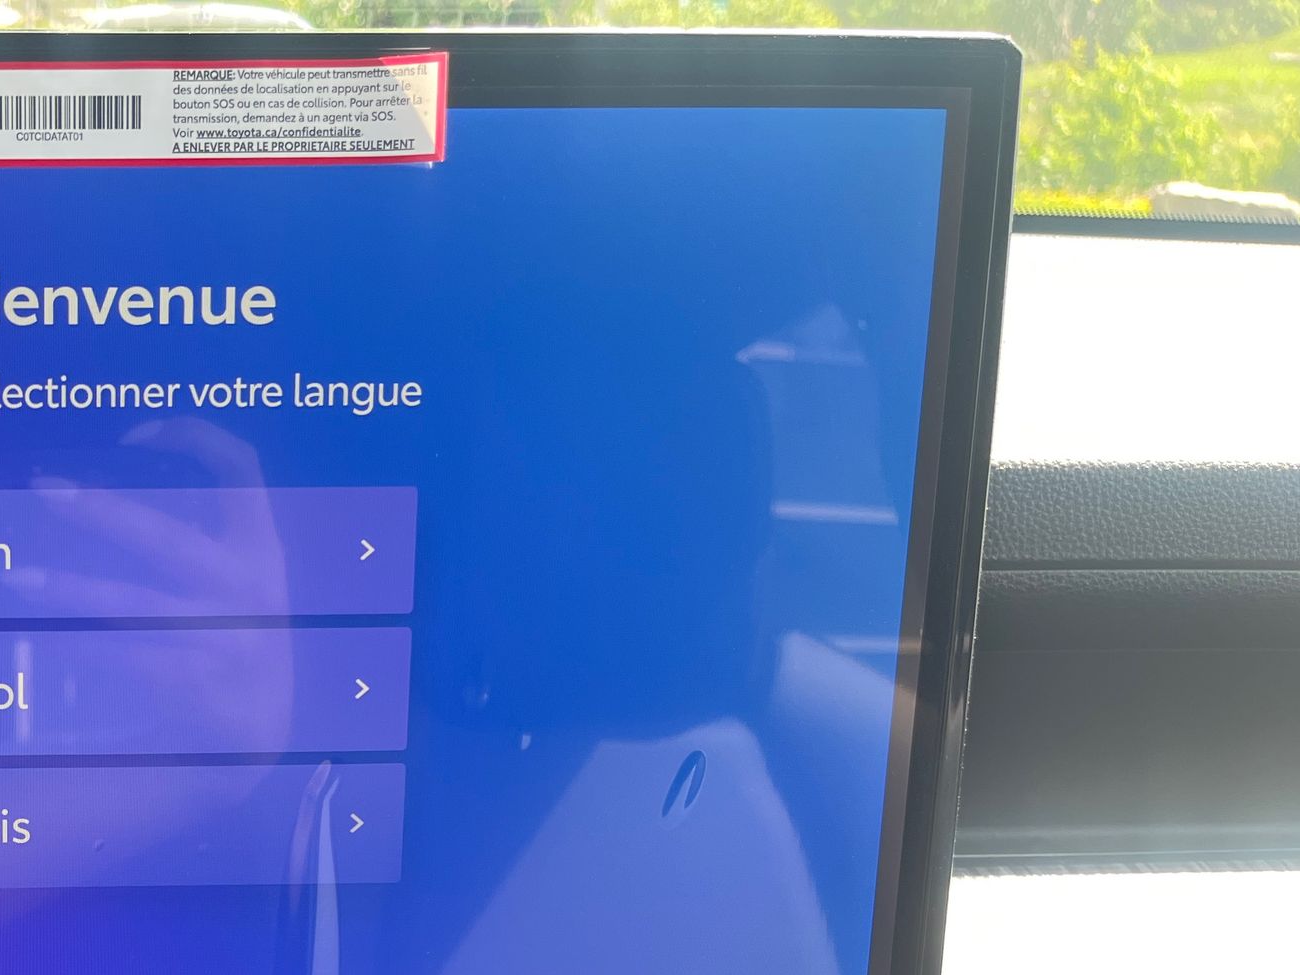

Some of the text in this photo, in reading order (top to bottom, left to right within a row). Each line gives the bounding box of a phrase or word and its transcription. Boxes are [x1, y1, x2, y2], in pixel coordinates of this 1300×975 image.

[173, 64, 427, 82] REMARQUE: Votre véhicule peut transmettre sans fil
[173, 85, 191, 95] des
[194, 84, 238, 95] données
[241, 84, 253, 94] de
[256, 84, 313, 94] localisation
[316, 86, 329, 94] en
[332, 84, 380, 96] appuyant
[402, 81, 411, 91] le
[173, 95, 422, 109] bouton SOS ou en cas de collision. Pour arrêter la
[173, 111, 396, 125] transmission, demandez à un agent via SOS.
[173, 127, 363, 139] Voir www.toyota.ca/confidentialite.
[172, 139, 415, 153] A ENLEVER PAR LE PROPRIETAIRE SEULEMENT
[189, 377, 281, 407] votre
[293, 373, 421, 415] langue
